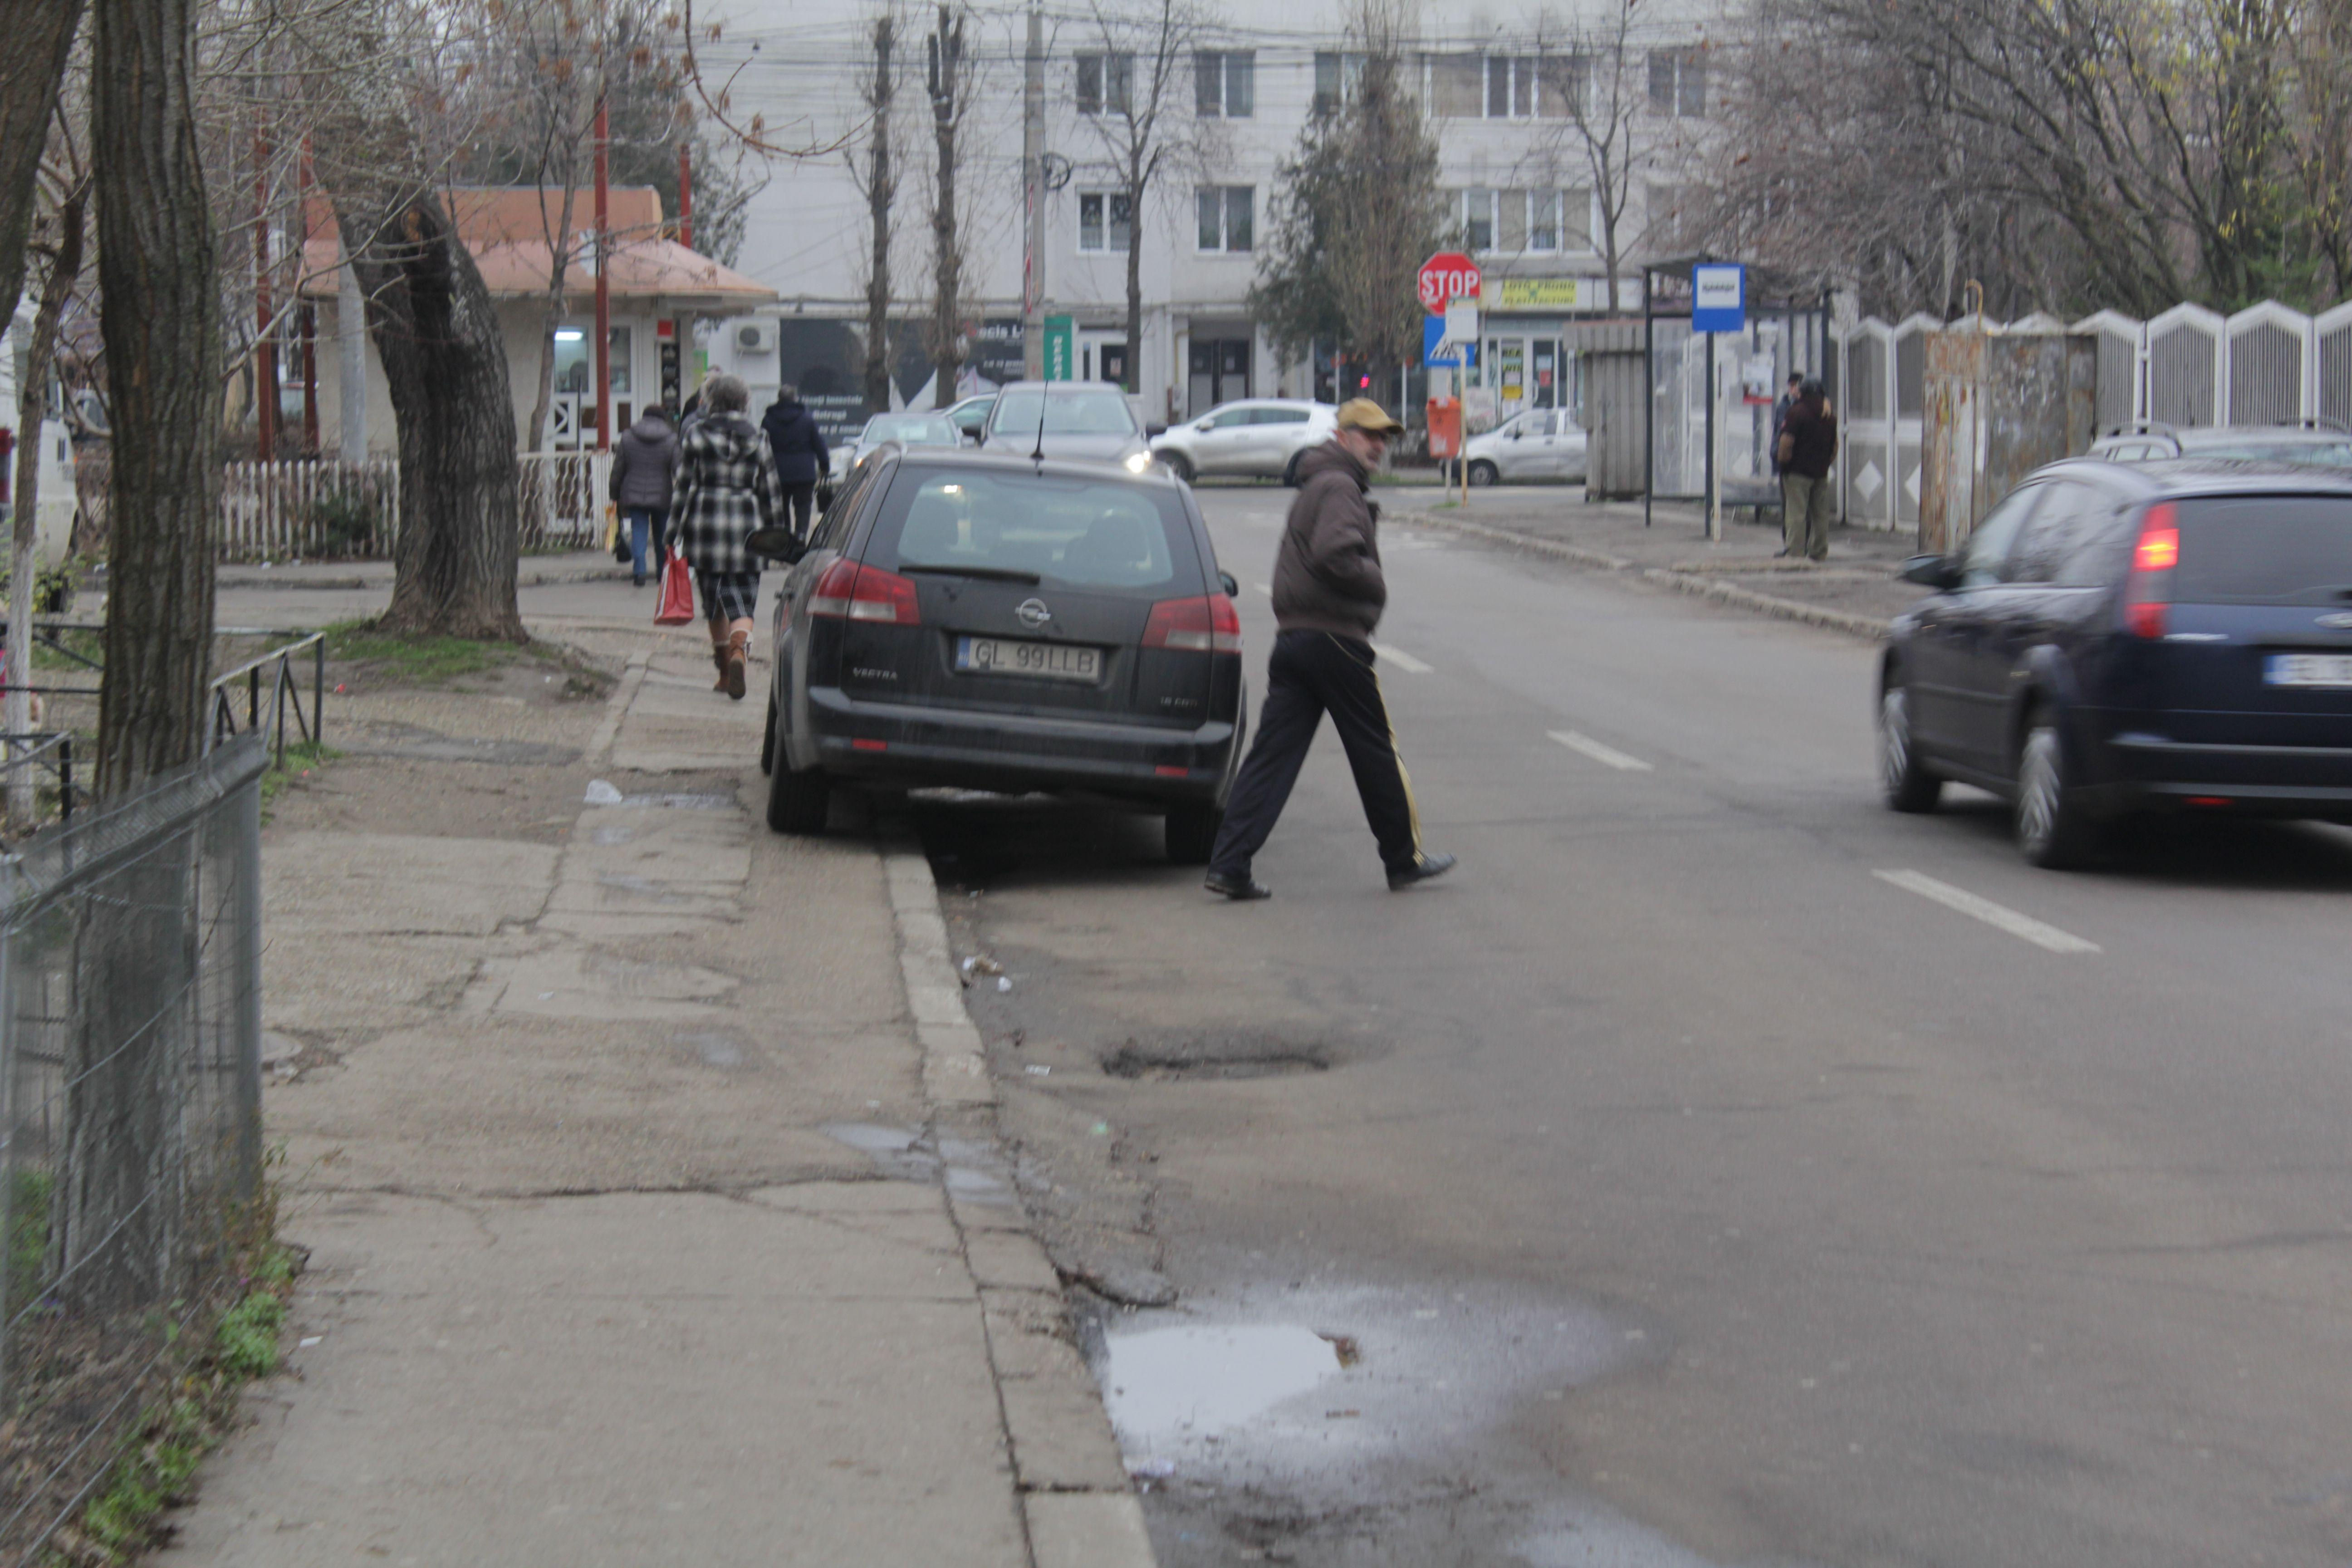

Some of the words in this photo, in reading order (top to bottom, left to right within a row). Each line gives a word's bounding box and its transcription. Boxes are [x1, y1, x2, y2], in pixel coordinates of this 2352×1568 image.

[1421, 270, 1479, 298] STOP
[976, 640, 1005, 665] GL
[1017, 644, 1044, 668] 99
[1049, 646, 1094, 673] LLB
[853, 667, 898, 680] VECTRA
